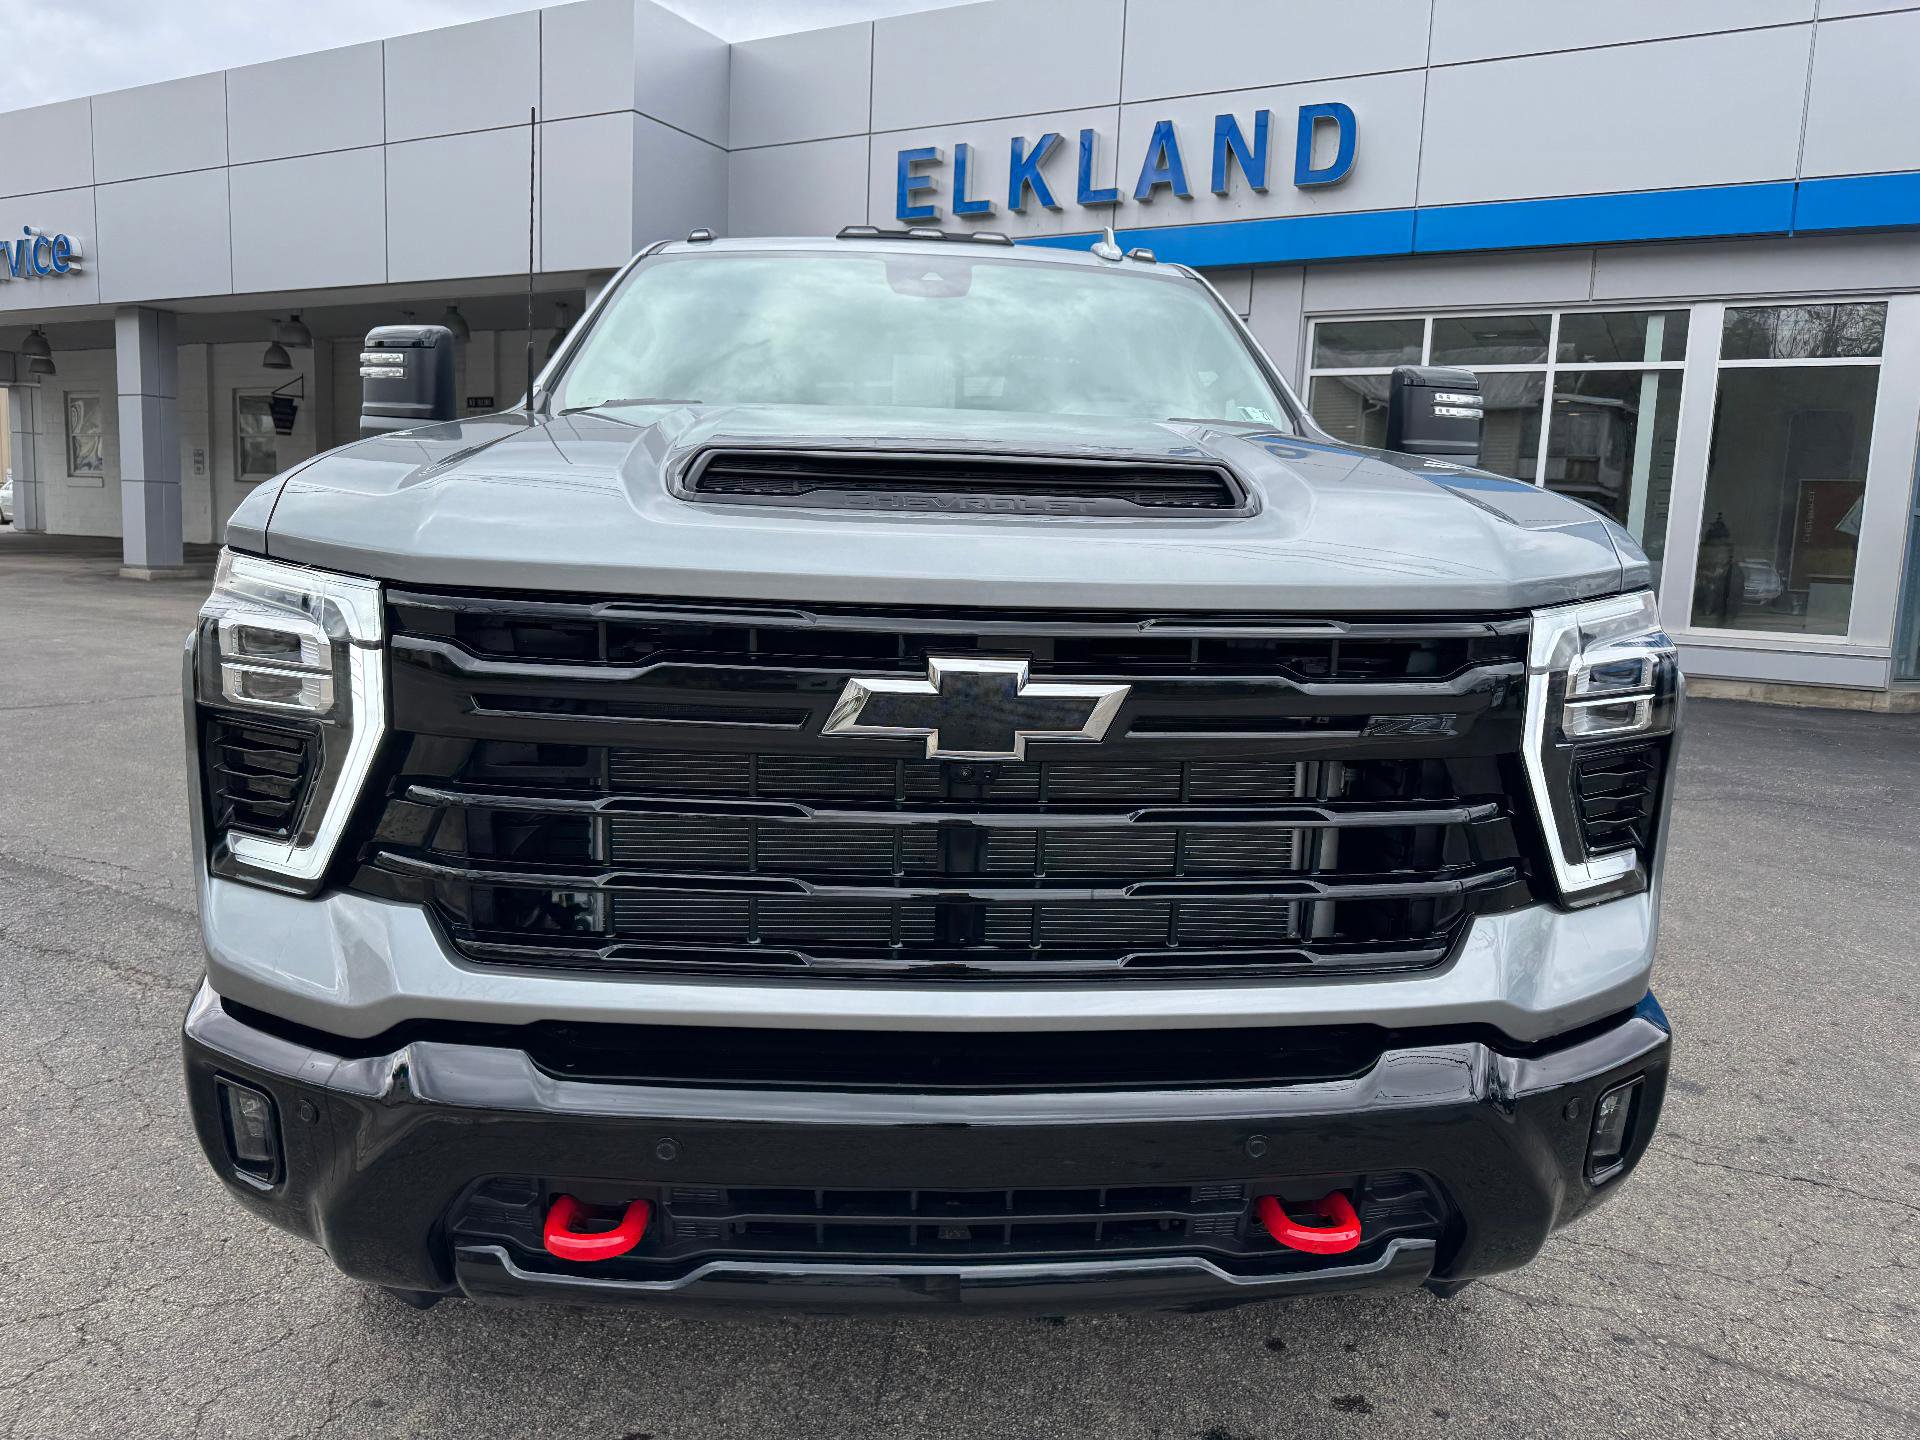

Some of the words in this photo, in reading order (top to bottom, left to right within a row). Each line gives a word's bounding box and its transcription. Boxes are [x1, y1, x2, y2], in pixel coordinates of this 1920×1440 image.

[897, 102, 1359, 221] ELKLAND
[844, 494, 1097, 513] CHEVROLET
[1362, 714, 1458, 736] Z71
